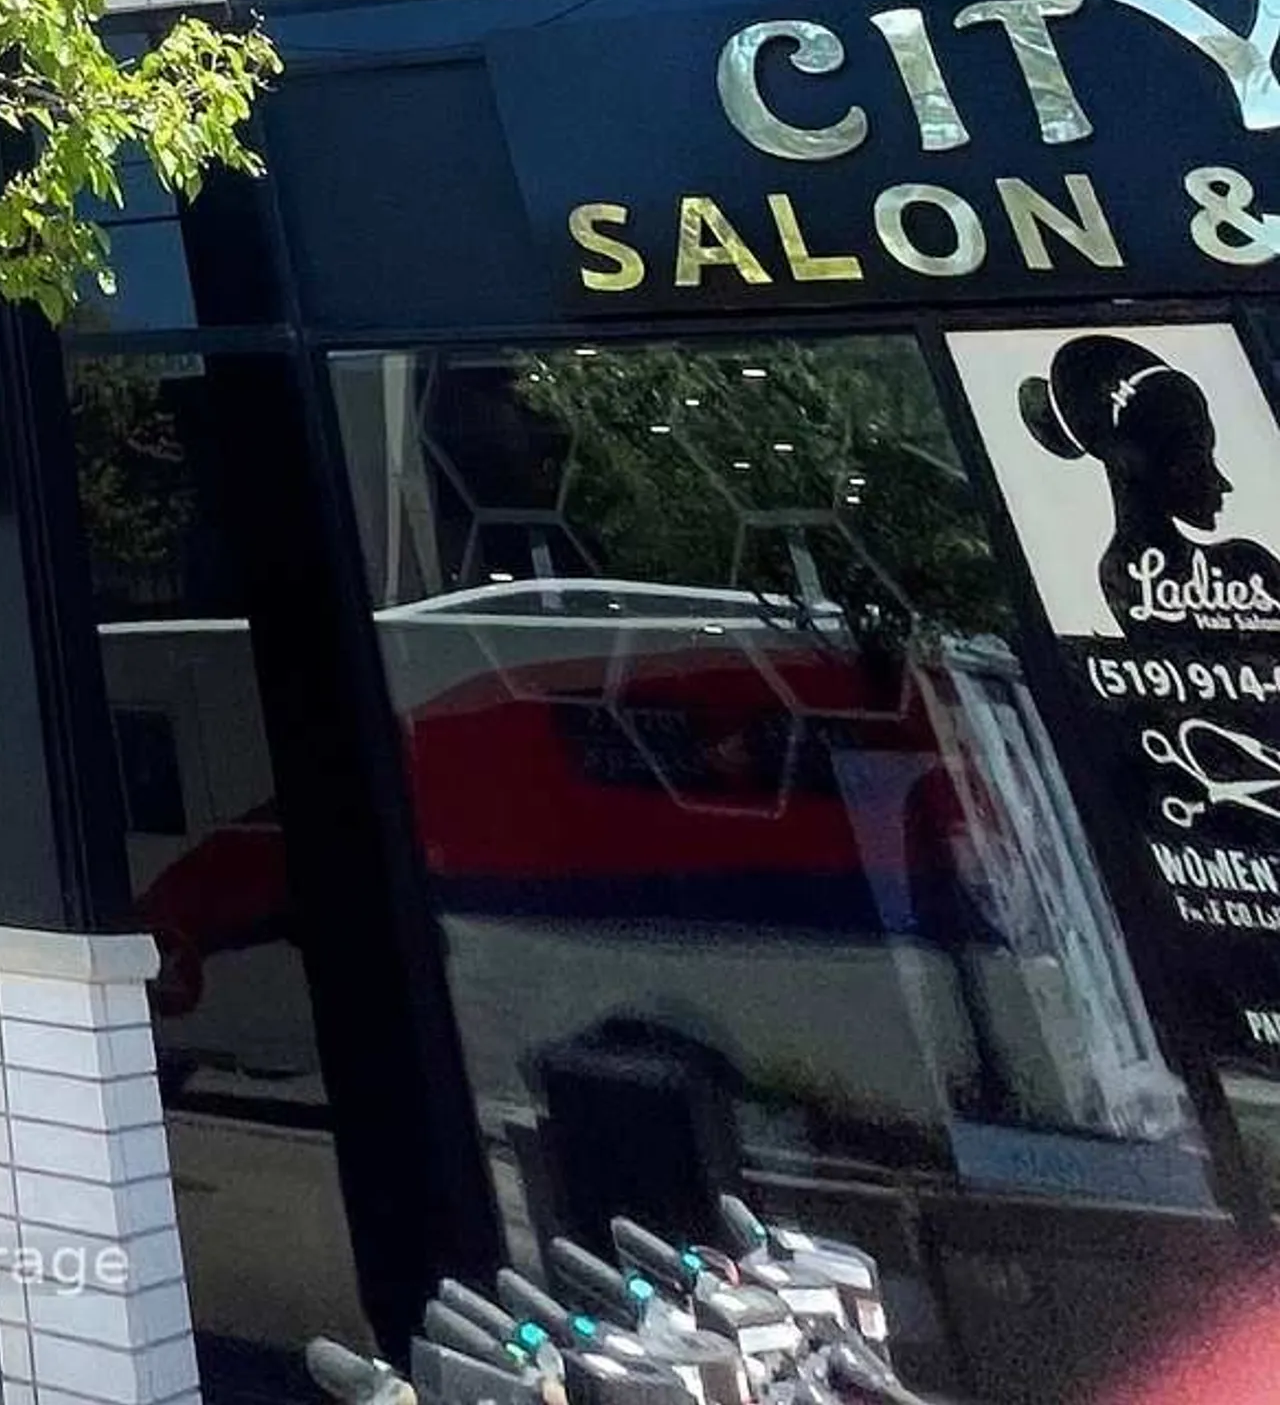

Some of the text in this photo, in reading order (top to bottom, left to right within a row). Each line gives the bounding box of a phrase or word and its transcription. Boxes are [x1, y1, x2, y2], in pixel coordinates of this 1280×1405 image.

[569, 167, 1280, 290] SALON &
[1127, 547, 1280, 622] Ladies
[1188, 662, 1280, 703] 914-
[1151, 842, 1280, 895] WOMEN
